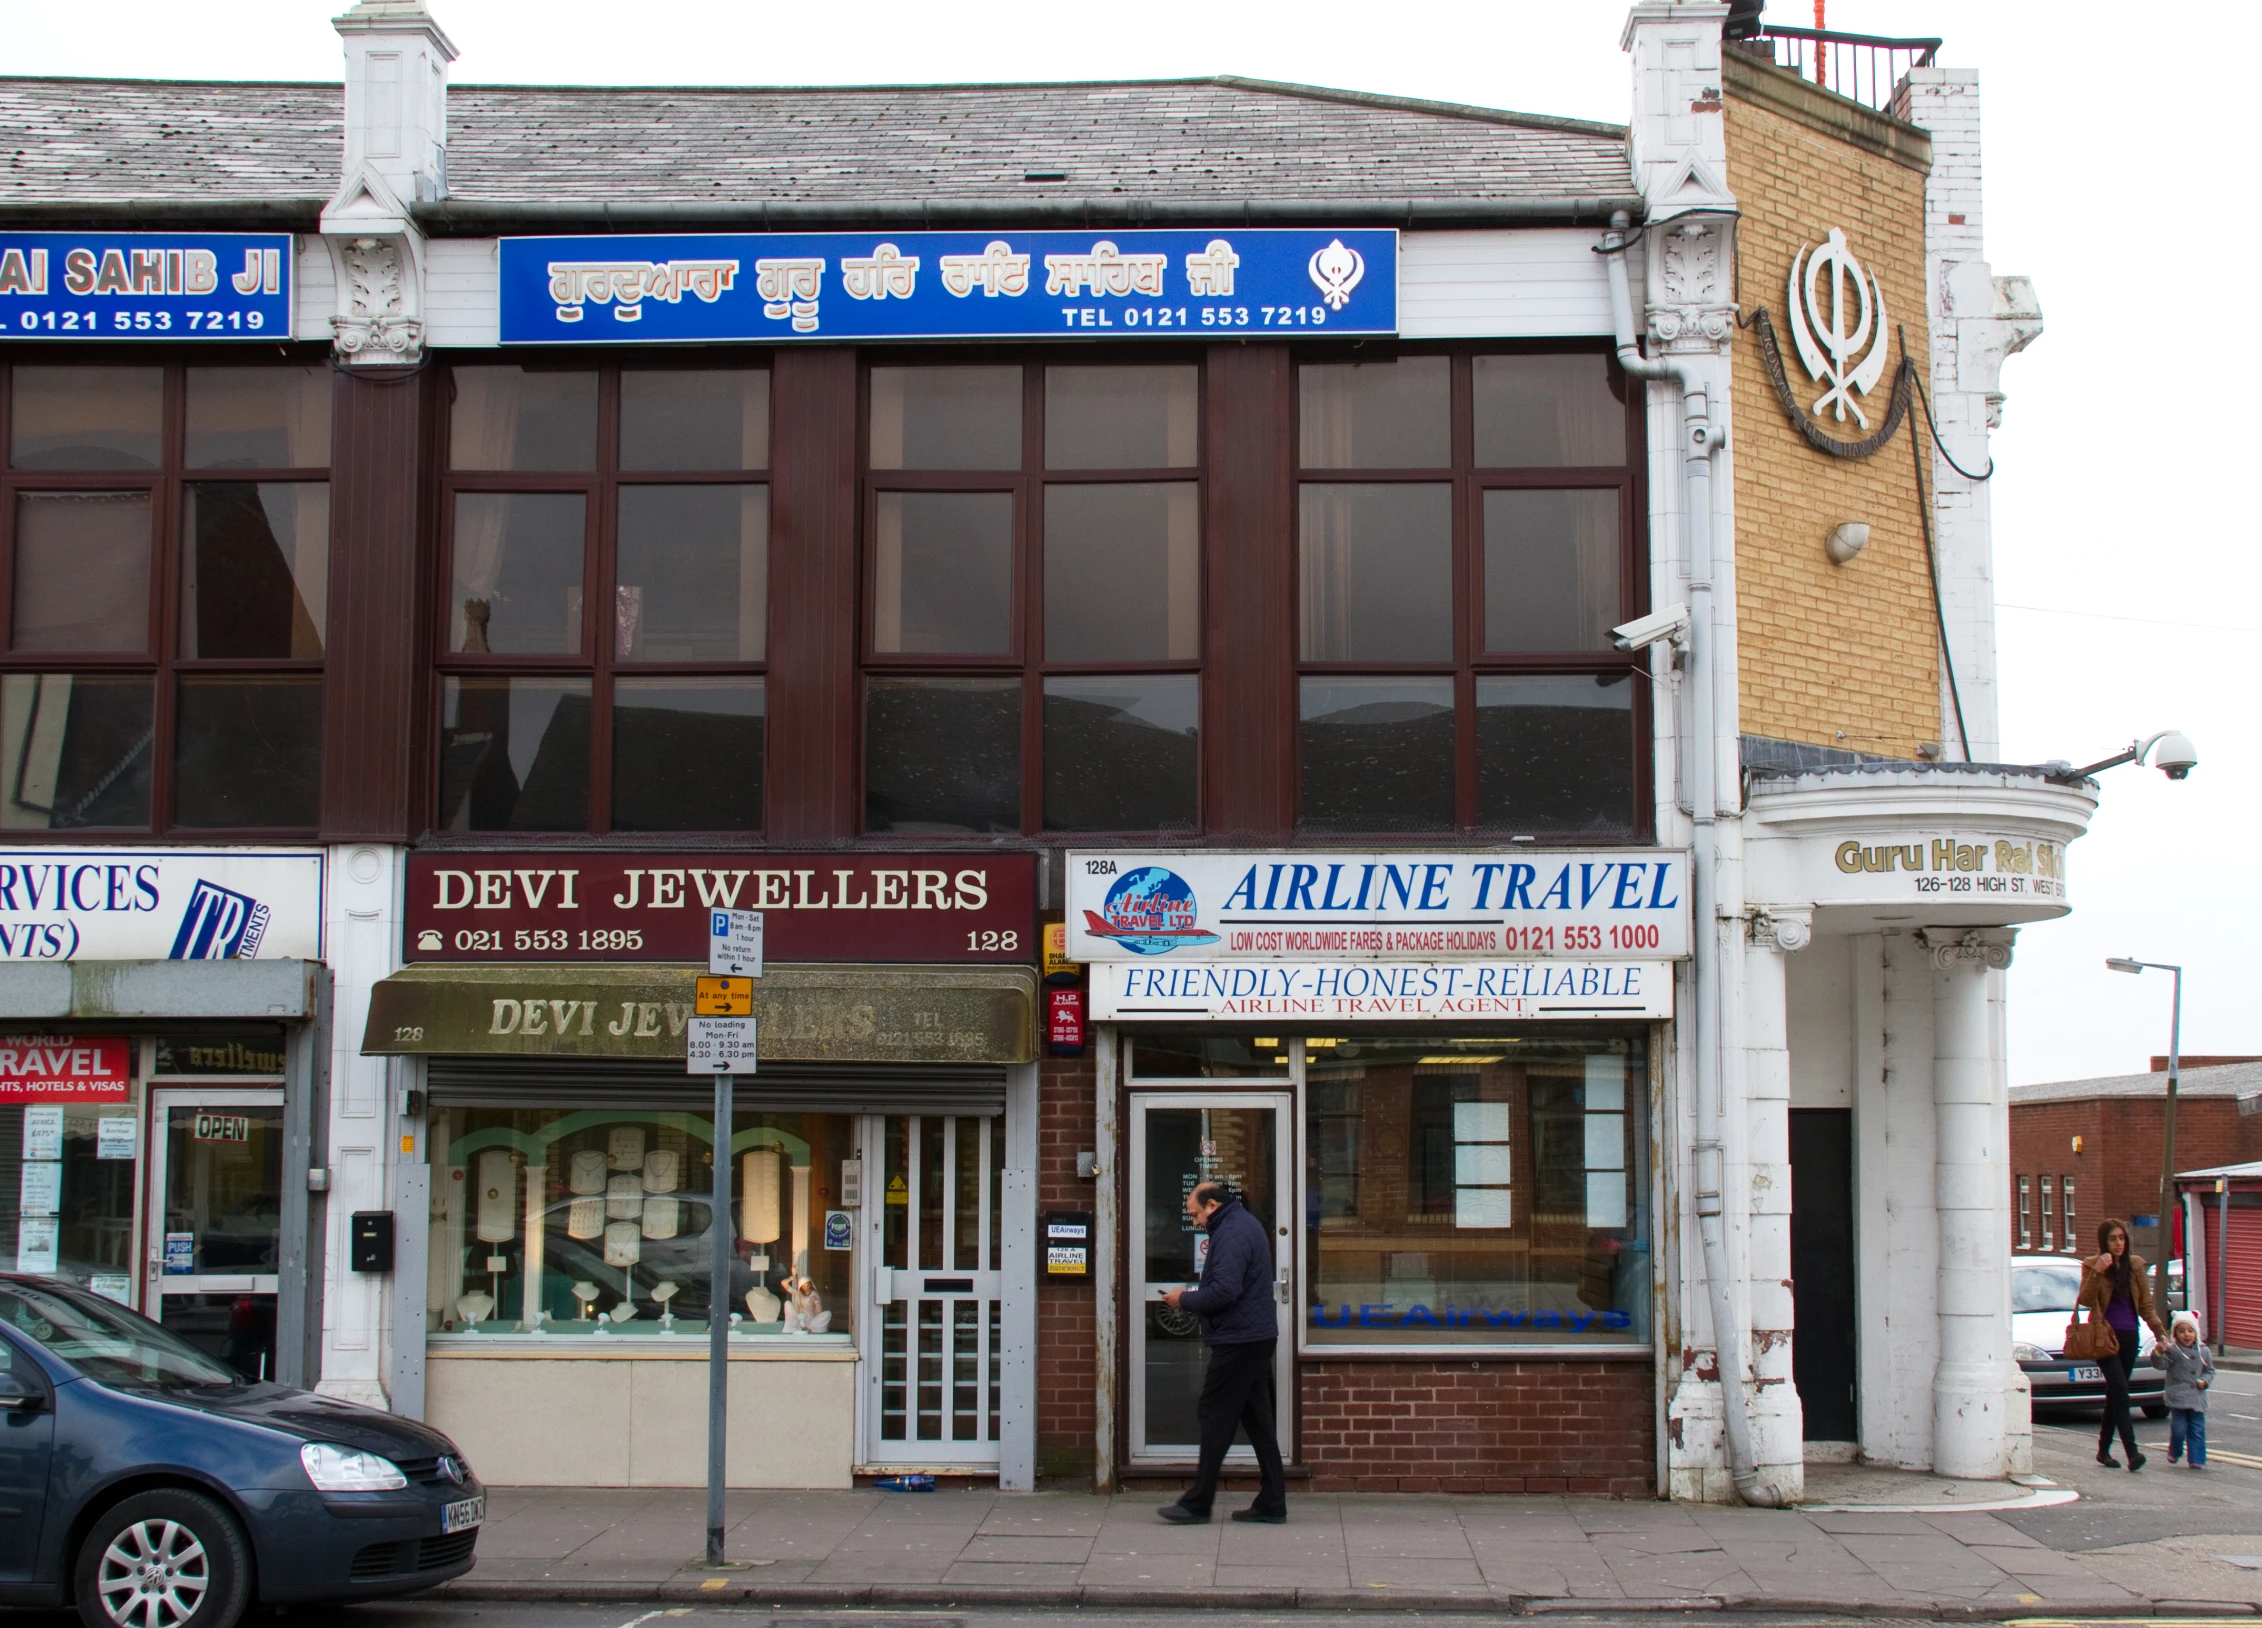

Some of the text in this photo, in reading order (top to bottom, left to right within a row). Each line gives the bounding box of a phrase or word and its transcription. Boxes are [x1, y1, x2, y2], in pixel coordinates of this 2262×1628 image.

[64, 248, 218, 295] SAHIB
[232, 248, 280, 295] JI
[755, 258, 825, 332] ਗੁਰੂ
[841, 242, 919, 299] ਹਰਿ
[1044, 240, 1167, 298] ਸਾਹਿਬ
[1186, 239, 1240, 298] ਜੀ
[21, 311, 97, 330] 0121
[114, 311, 172, 330] 553
[186, 311, 264, 330] 7219
[1062, 306, 1326, 326] TEL 0121 553 7219
[1835, 841, 1924, 873] Guru
[1931, 839, 1988, 872] Har
[1995, 839, 2033, 874] Rai
[1085, 860, 1117, 875] 128A
[433, 869, 988, 910] DEVI JEWELLERS
[1221, 863, 1679, 911] AIRLINE TRAVEL
[1914, 877, 1971, 892] 126-128
[1977, 877, 2006, 892] HIGH
[2033, 879, 2054, 895] WEST
[1105, 893, 1195, 914] Airline
[715, 916, 726, 934] P
[732, 913, 744, 921] Mon
[749, 914, 760, 922] Sat
[1111, 914, 1194, 928] TRAVEL LTD
[455, 929, 1018, 951] 021 553 1895 128
[740, 934, 755, 942] hour
[1230, 931, 1496, 950] LOW COST WORLDWIDE FARES & PACKAGE HOLIDAYS
[1505, 924, 1659, 950] 0121 553 1000
[717, 952, 735, 961] within
[732, 945, 752, 953] return
[712, 993, 727, 1001] any
[1221, 998, 1527, 1013] AIRLINE TRAVEL AGENT
[488, 999, 598, 1035] DEVI
[715, 1021, 746, 1029] loading
[394, 1026, 424, 1042] 128
[26, 1082, 74, 1091] HOTELS
[77, 1082, 85, 1091] &
[90, 1082, 125, 1091] VISAS
[199, 1115, 246, 1141] OPEN
[1051, 1226, 1084, 1234] UEAirways
[168, 1242, 192, 1252] PUSH
[1314, 1304, 1631, 1333] UEAirways
[448, 1503, 470, 1527] KN56
